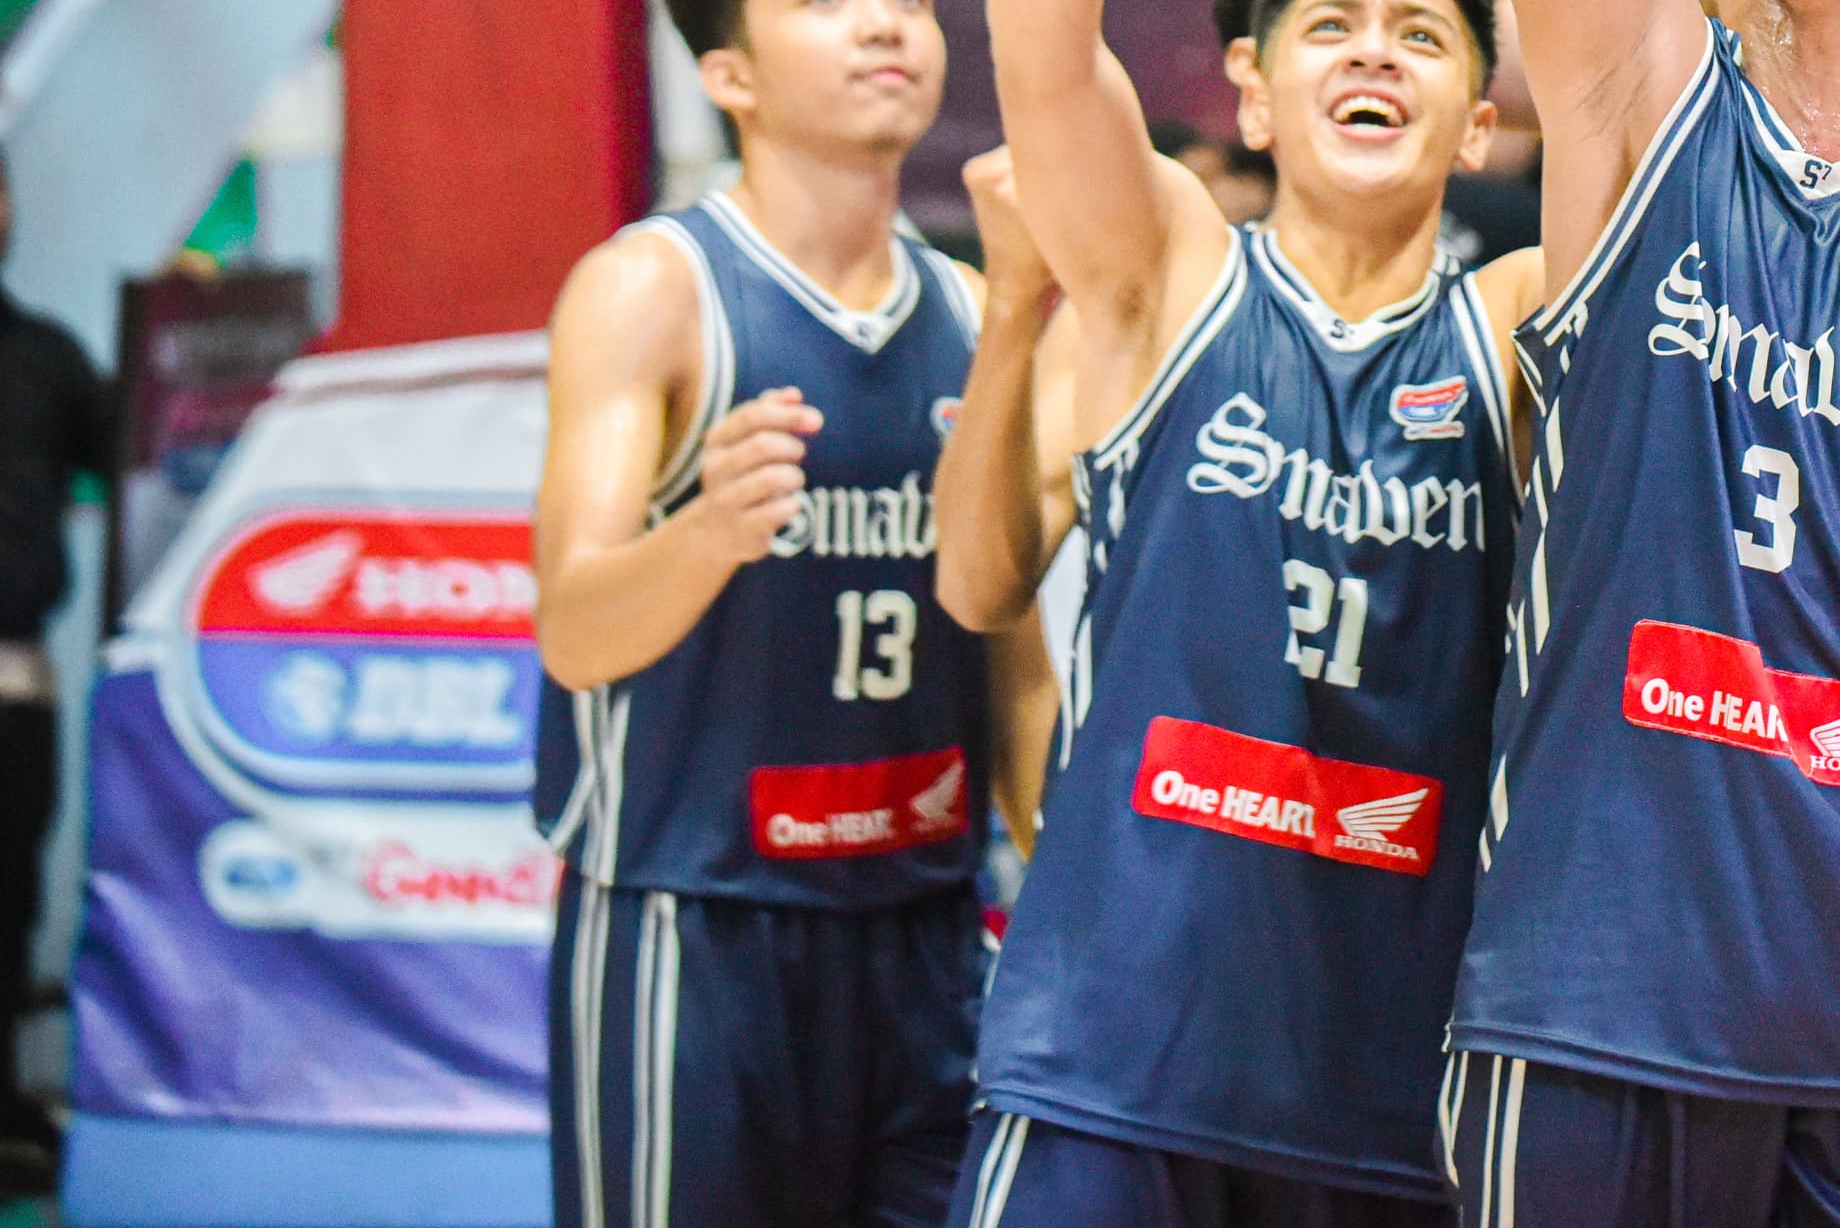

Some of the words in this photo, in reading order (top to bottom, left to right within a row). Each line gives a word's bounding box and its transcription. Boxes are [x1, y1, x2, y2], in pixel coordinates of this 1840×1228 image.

[1733, 444, 1800, 574] 3
[832, 589, 917, 701] 13
[1282, 558, 1369, 689] 21
[1641, 677, 1705, 721] One
[1709, 690, 1788, 743] HEAR
[1151, 770, 1219, 814] One
[1334, 834, 1421, 861] HONDA
